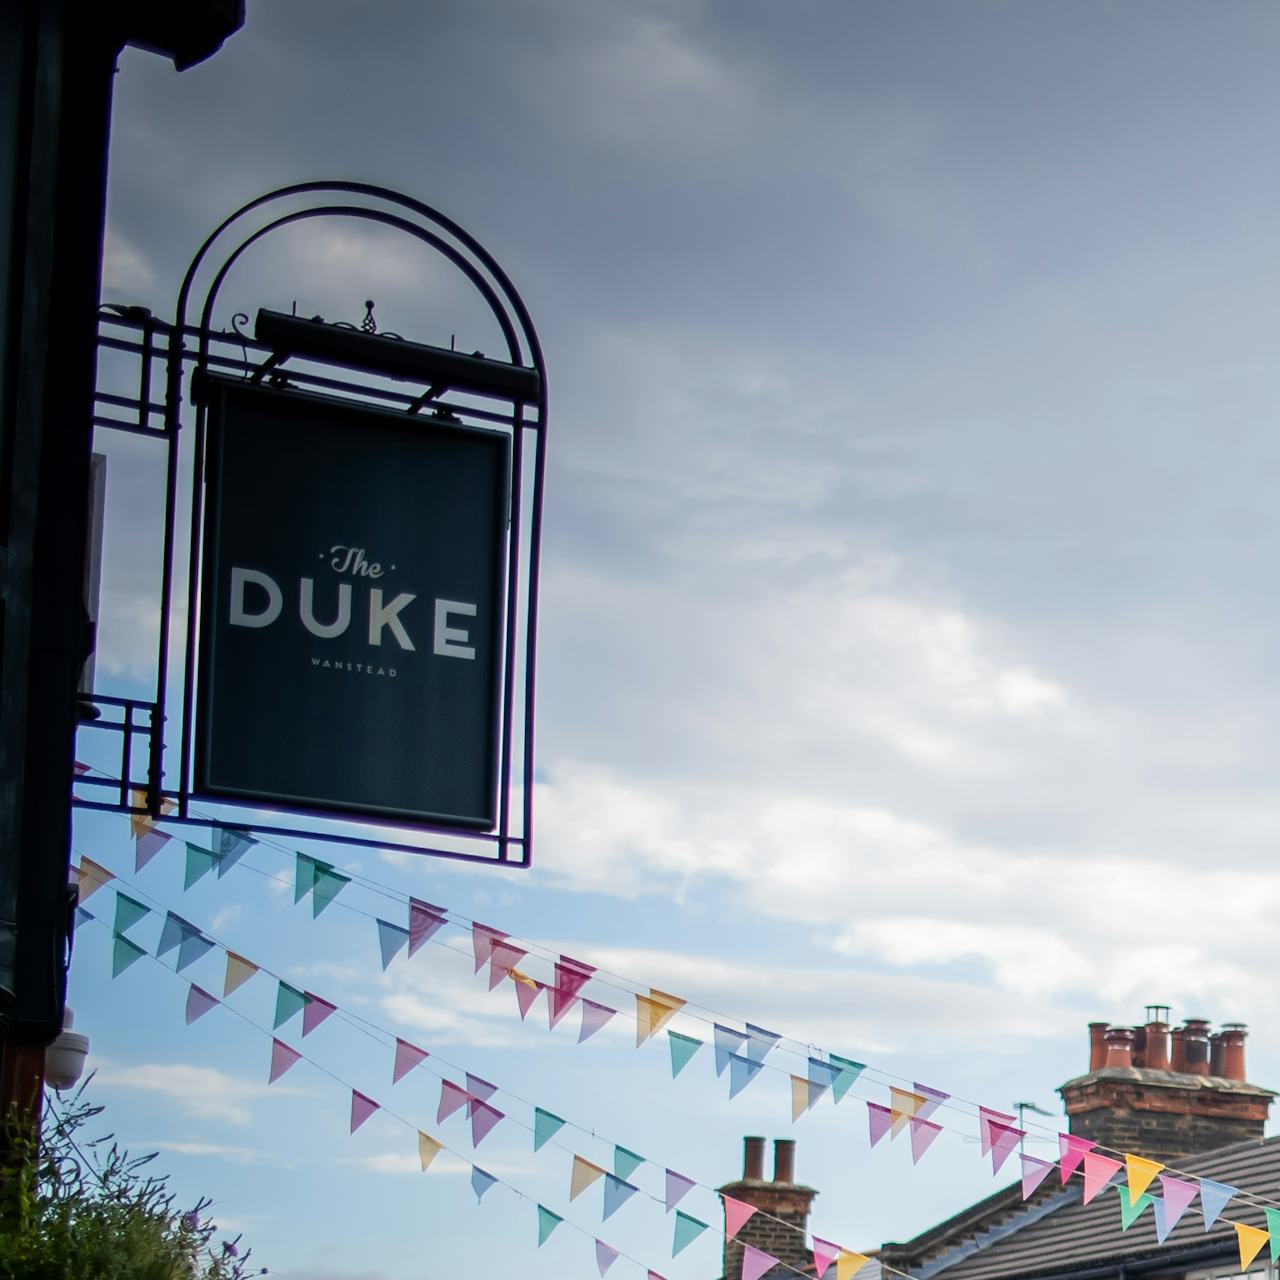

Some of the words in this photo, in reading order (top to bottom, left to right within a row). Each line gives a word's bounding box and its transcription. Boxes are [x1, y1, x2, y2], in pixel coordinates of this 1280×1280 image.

[330, 545, 384, 579] The
[230, 566, 477, 660] DUKE
[311, 657, 397, 677] WANSTEAD
